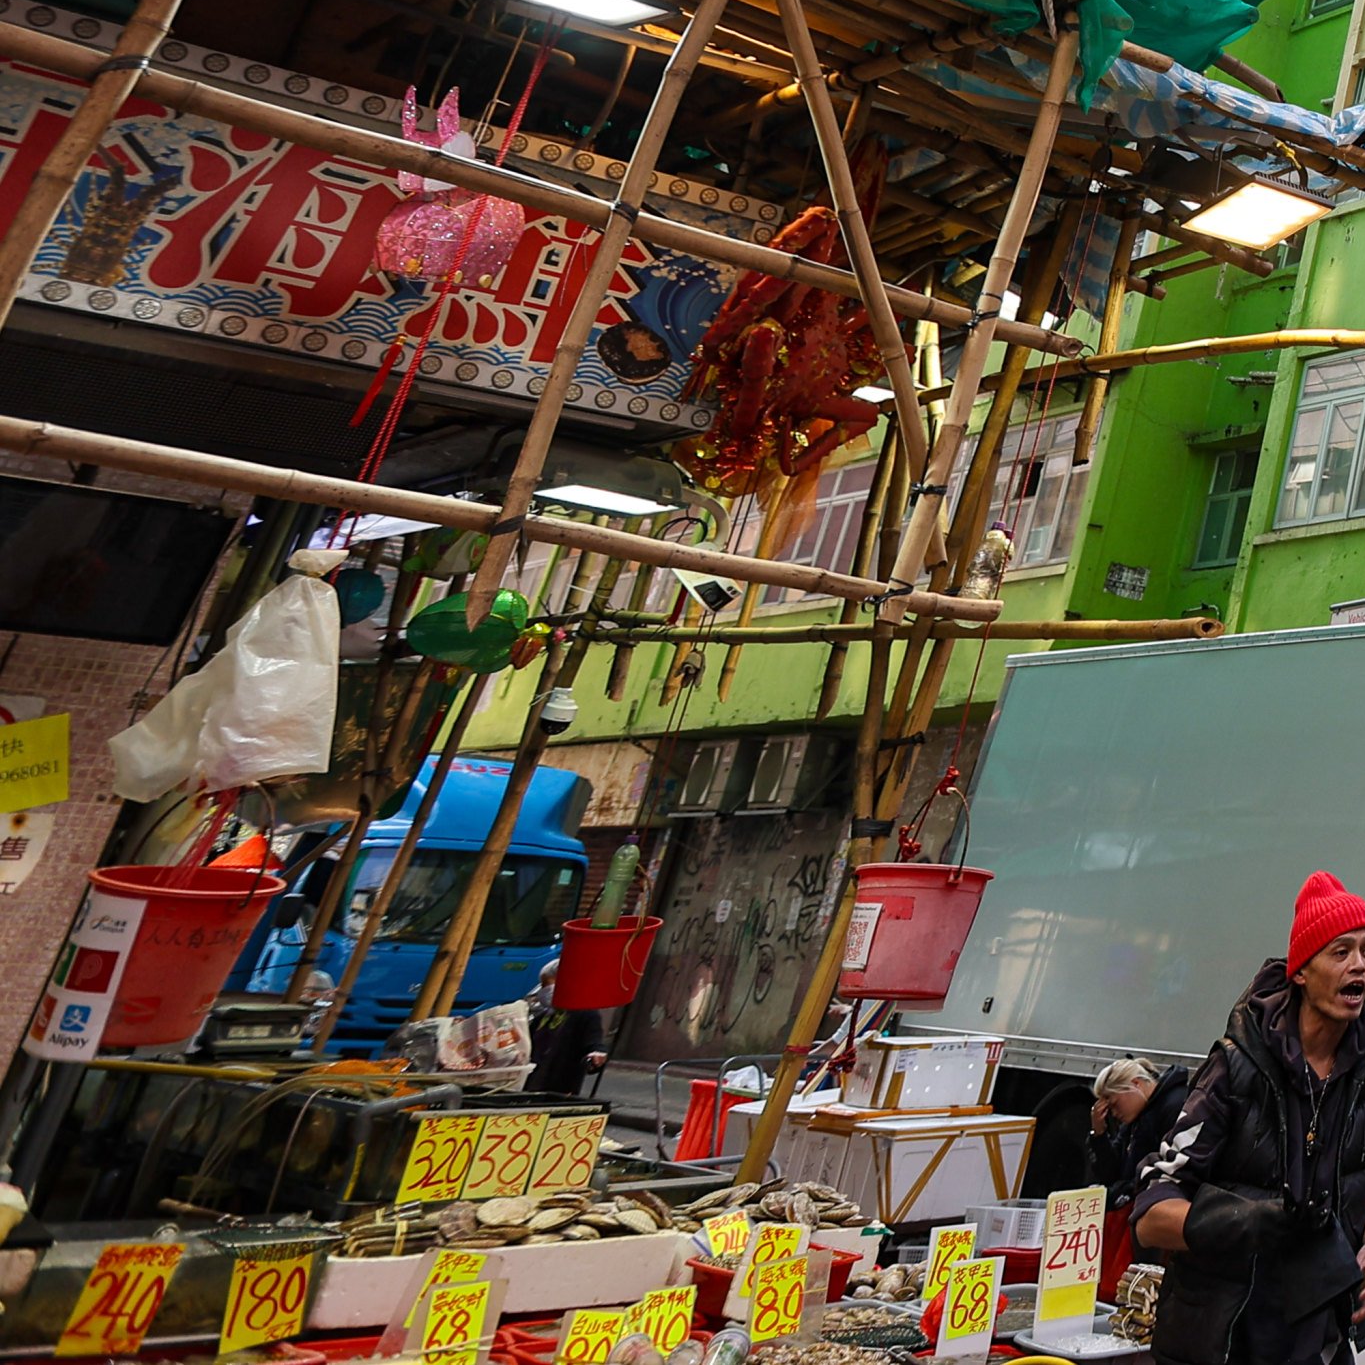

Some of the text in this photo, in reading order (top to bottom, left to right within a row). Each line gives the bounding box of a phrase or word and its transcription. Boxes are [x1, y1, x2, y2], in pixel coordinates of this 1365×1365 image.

[48, 1033, 90, 1049] Alipay
[407, 1137, 473, 1191] 320
[468, 1129, 532, 1189] 38
[532, 1137, 593, 1189] 28
[928, 1244, 968, 1288] 16
[1045, 1223, 1101, 1270] 240
[63, 1270, 165, 1340] 240
[227, 1266, 306, 1339] 180
[754, 1280, 804, 1333] 80
[950, 1280, 990, 1329] 68
[424, 1308, 472, 1364] 68
[644, 1311, 690, 1352] 110
